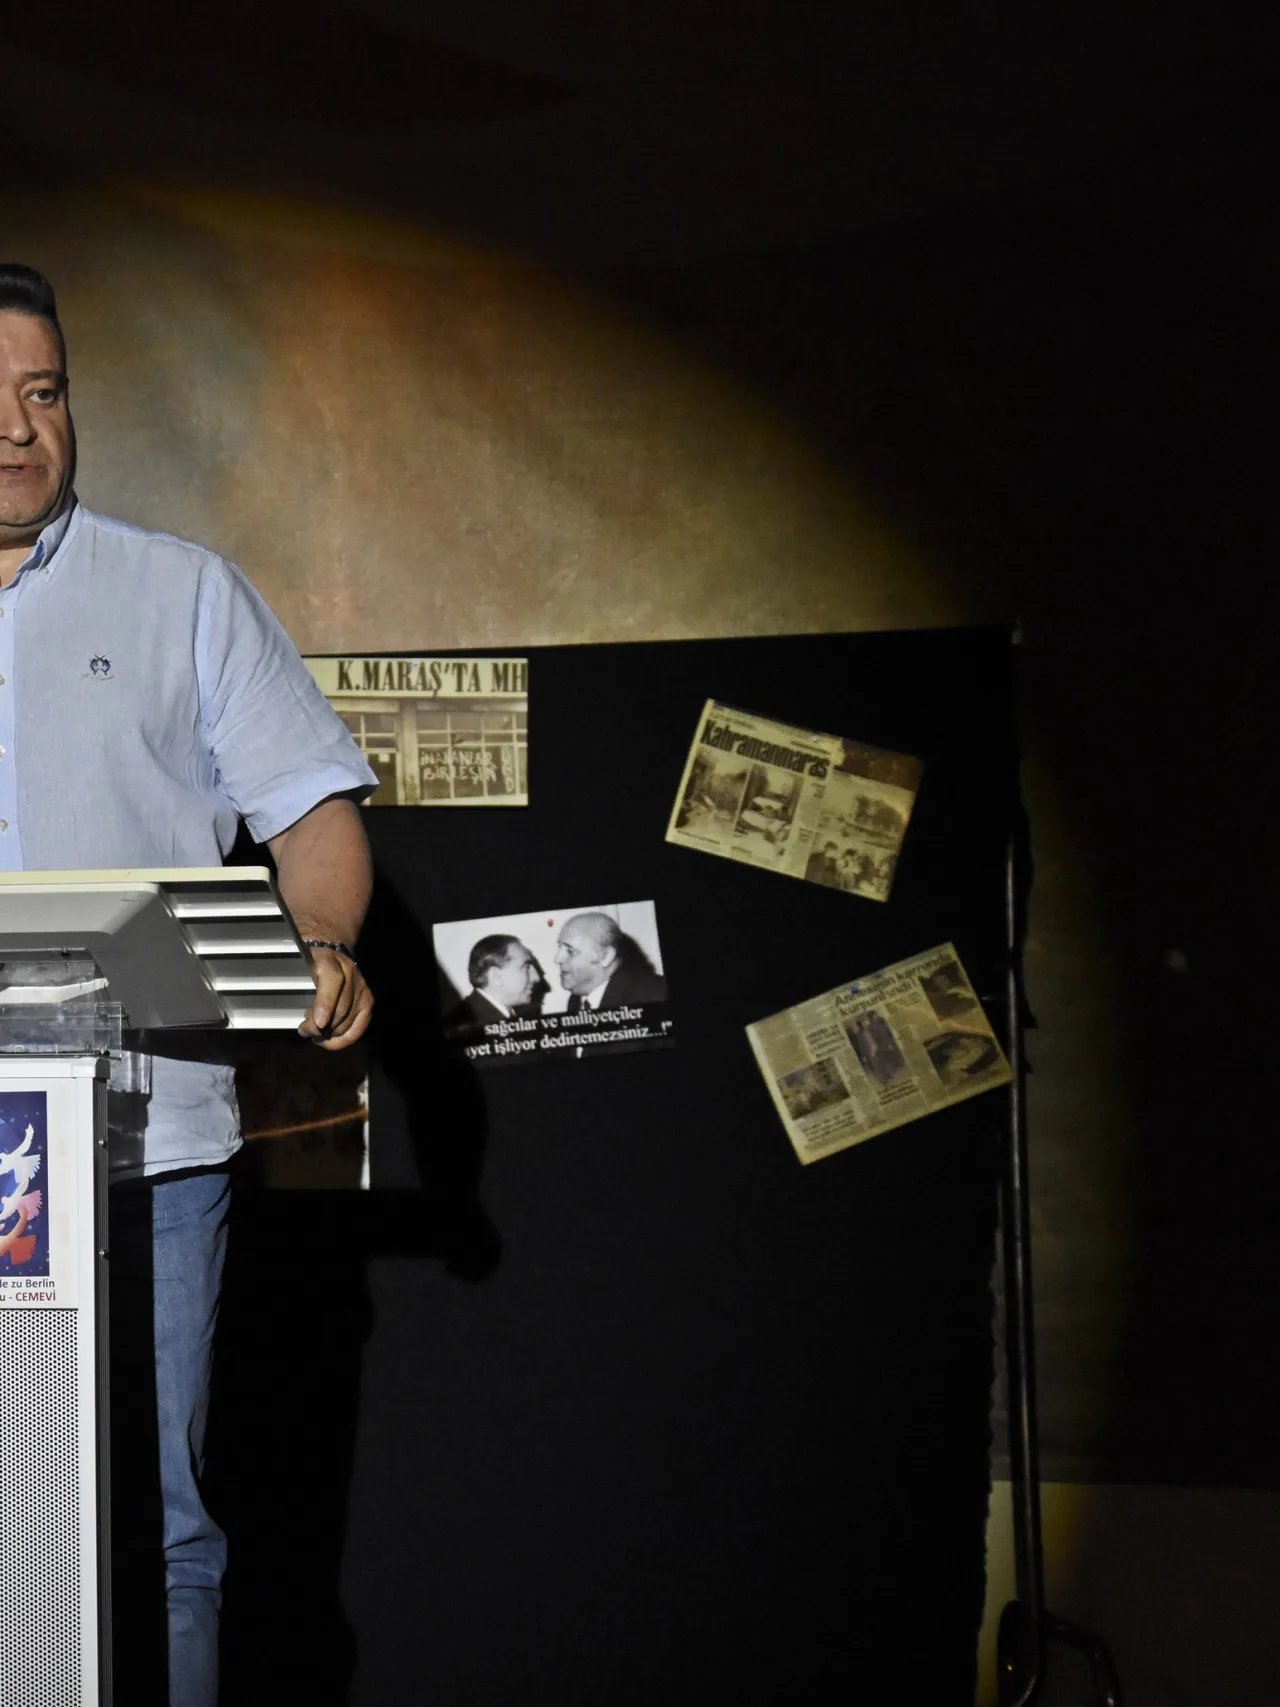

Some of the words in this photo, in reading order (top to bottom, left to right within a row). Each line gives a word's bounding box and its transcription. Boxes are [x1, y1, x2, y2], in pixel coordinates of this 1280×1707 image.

[336, 660, 481, 698] K.MARAŞ'TA
[542, 1016, 558, 1029] ve
[561, 1006, 644, 1029] milliyetçiler
[495, 1037, 537, 1056] işliyor
[11, 1280, 22, 1288] zu
[25, 1279, 55, 1288] Berlin
